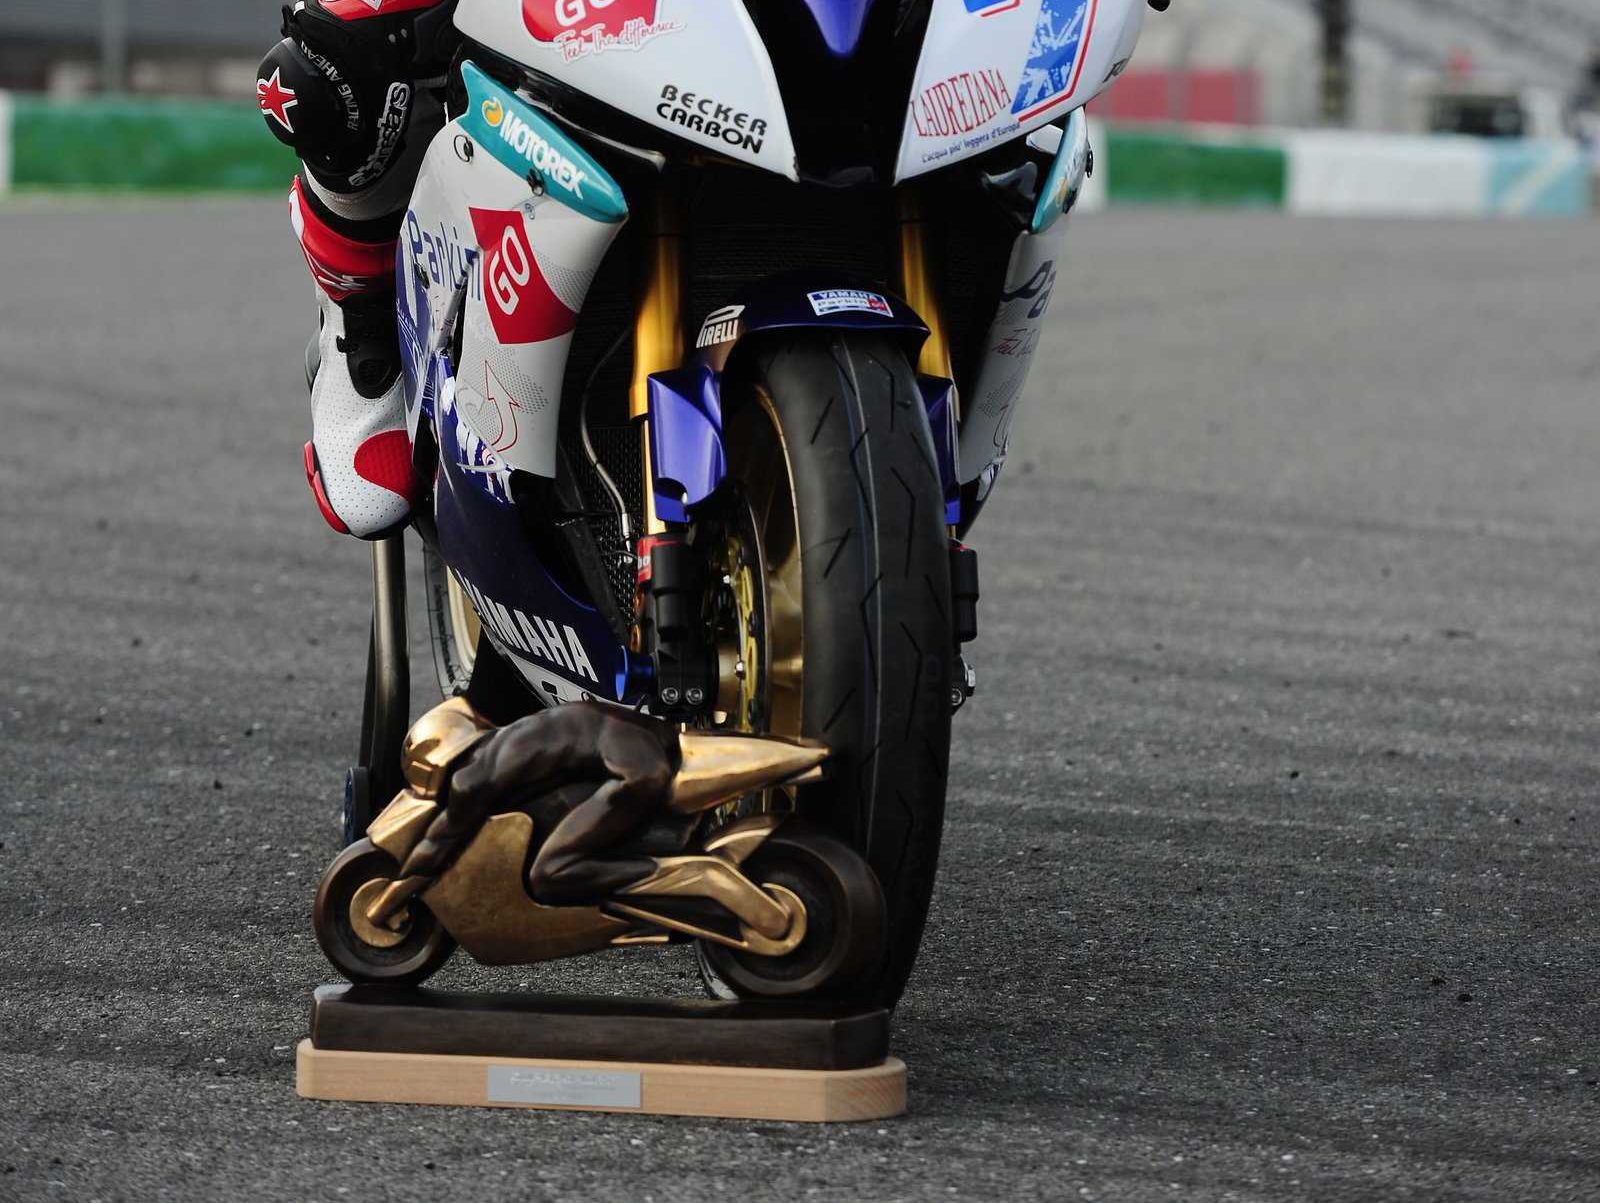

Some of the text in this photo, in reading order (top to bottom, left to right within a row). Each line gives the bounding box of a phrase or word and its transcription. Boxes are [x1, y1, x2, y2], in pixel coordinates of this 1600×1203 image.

[555, 31, 588, 61] Feel
[582, 24, 615, 50] The
[301, 41, 359, 131] RACING AHEAD
[660, 85, 767, 135] BECKER
[910, 69, 1012, 136] LAURETANA
[657, 103, 763, 154] CARBON
[500, 111, 585, 198] MOTOREX
[489, 225, 530, 315] GO
[819, 291, 878, 301] YAMAHA
[696, 305, 745, 347] PIRELLI
